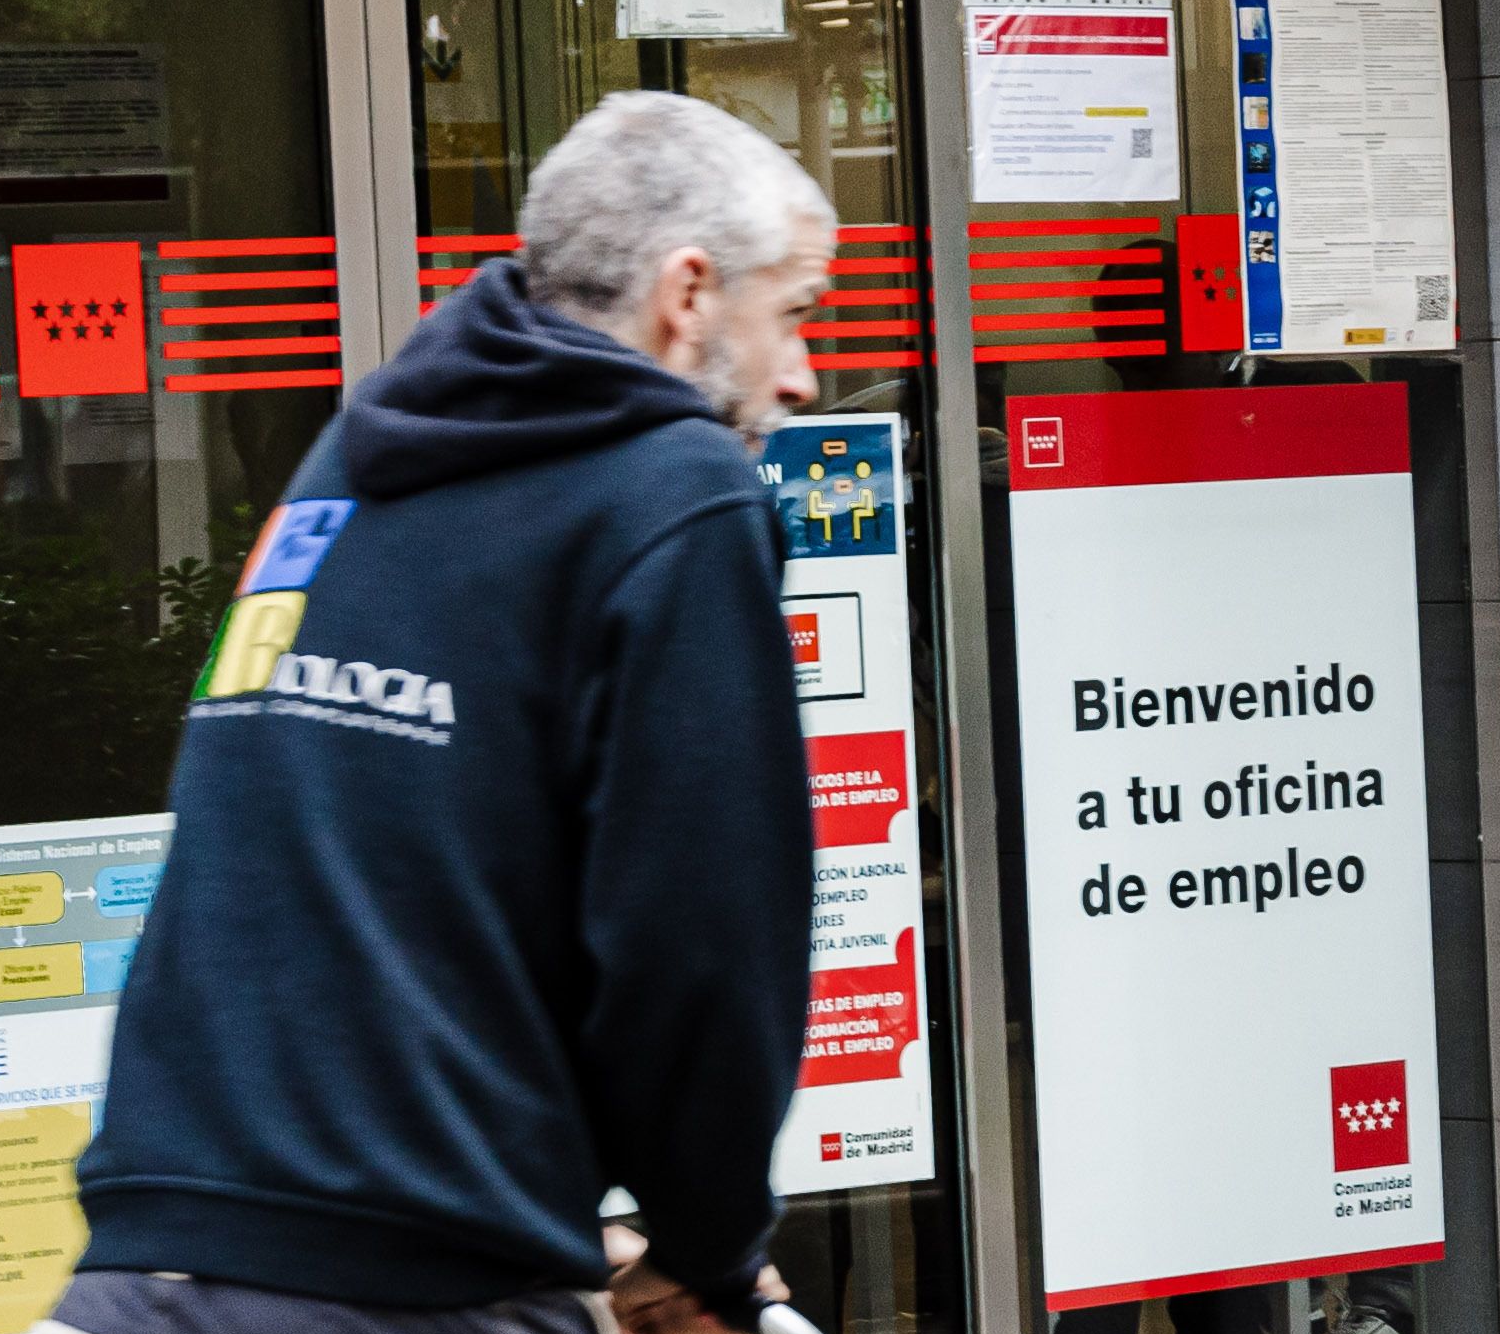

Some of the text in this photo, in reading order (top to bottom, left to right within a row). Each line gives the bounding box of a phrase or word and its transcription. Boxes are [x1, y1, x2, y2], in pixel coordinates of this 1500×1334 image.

[1073, 663, 1375, 732] Bienvenido
[846, 771, 864, 786] DE
[866, 770, 883, 784] LA
[831, 792, 848, 806] DE
[850, 788, 900, 805] EMPLEO
[1077, 760, 1385, 830] a tu oficina
[42, 843, 98, 860] Nacional
[99, 842, 116, 854] de
[116, 838, 163, 855] Empleo
[852, 862, 908, 879] LABORAL
[1082, 847, 1365, 917] de empleo
[840, 933, 889, 949] JUVENIL
[835, 996, 853, 1011] DE
[855, 992, 904, 1008] EMPLEO
[827, 1041, 843, 1055] EL
[843, 1036, 895, 1054] EMPLEO
[845, 1127, 914, 1144] Comunidad
[845, 1141, 914, 1158] de Madrid
[1334, 1173, 1412, 1196] Comunidad
[1335, 1194, 1413, 1217] de Madrid
